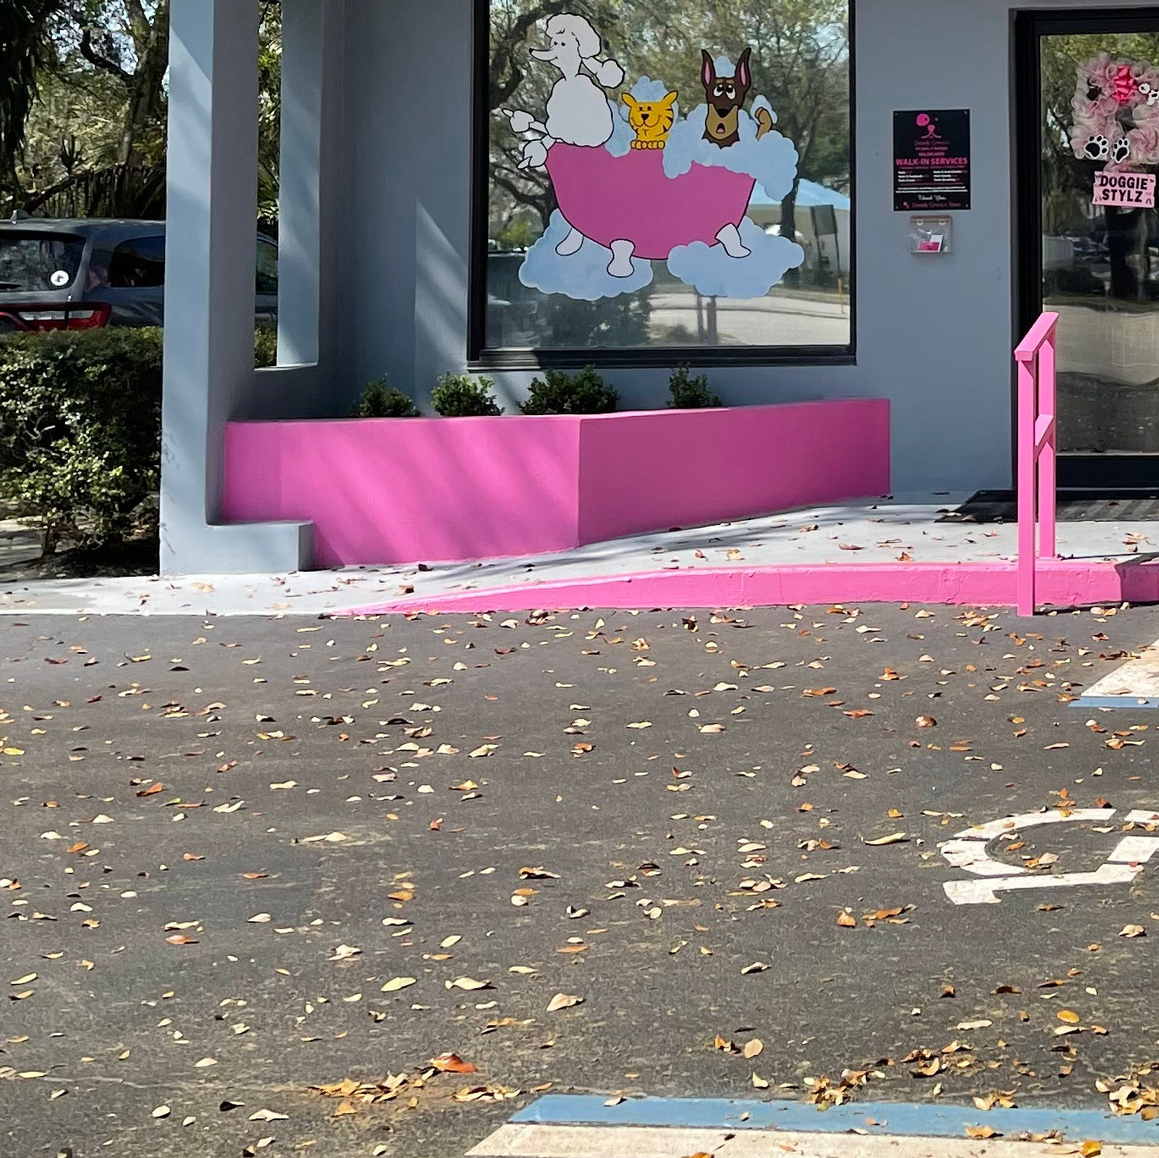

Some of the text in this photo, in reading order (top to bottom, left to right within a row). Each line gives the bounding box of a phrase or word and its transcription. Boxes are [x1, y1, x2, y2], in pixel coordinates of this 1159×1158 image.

[895, 157, 968, 166] WALK-IN SERVICES
[1099, 175, 1149, 190] DOGGIE
[1102, 189, 1143, 203] STYLZ
